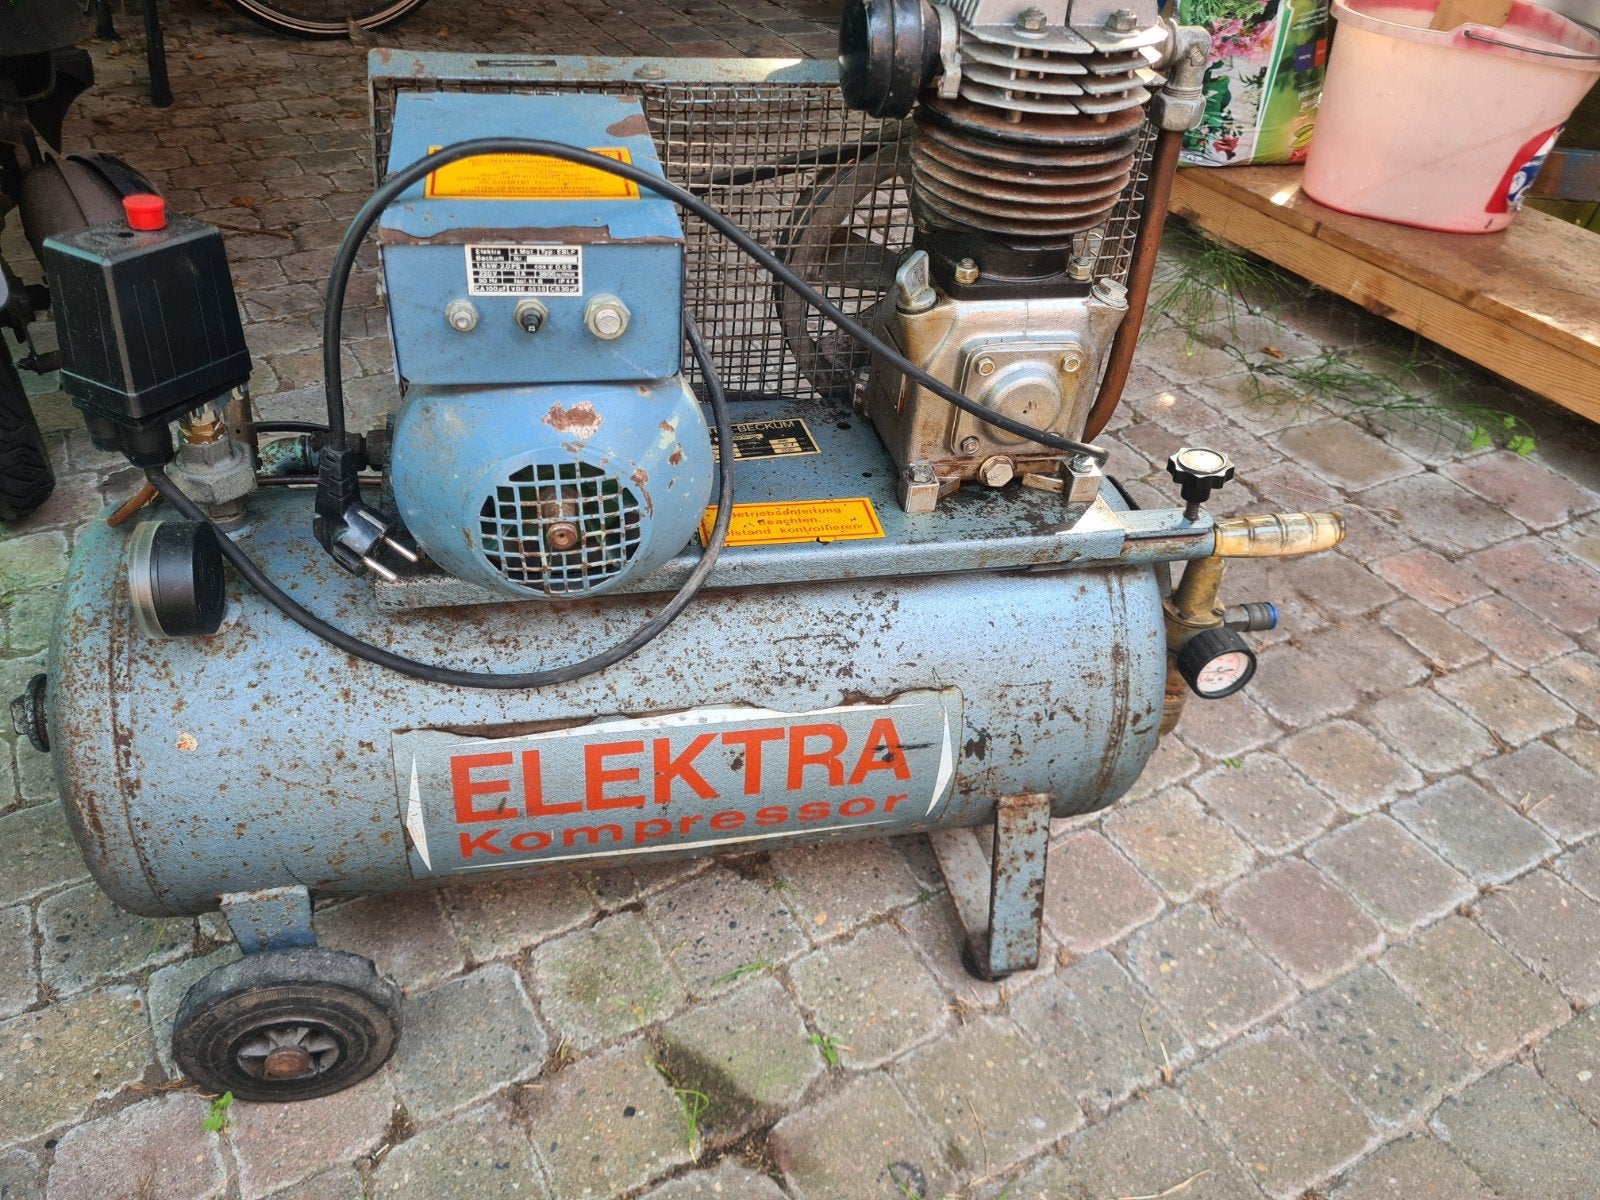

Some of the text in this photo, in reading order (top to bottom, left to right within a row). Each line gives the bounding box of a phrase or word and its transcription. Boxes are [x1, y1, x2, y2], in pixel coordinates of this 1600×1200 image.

[726, 528, 771, 536] lstand
[450, 718, 912, 824] ELEKTRA
[458, 792, 910, 859] Kompressor
